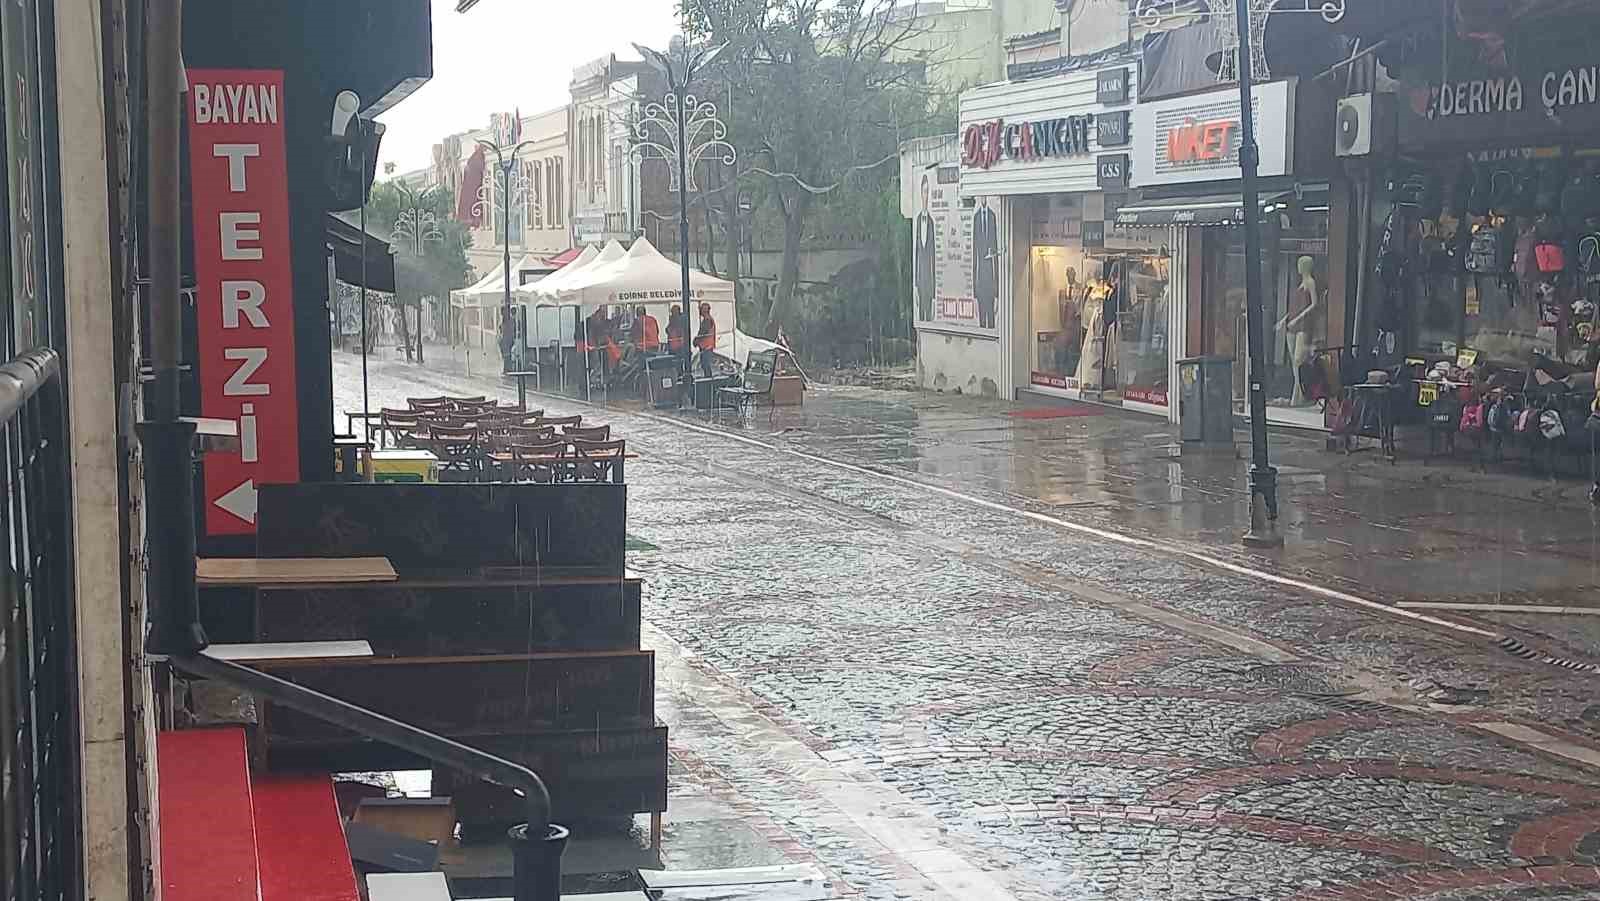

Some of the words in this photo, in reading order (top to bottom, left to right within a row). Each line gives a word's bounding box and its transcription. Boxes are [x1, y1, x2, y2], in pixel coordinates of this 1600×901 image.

[194, 84, 278, 124] BAYAN
[1439, 77, 1522, 116] DERMA
[1541, 66, 1600, 119] ÇAN
[213, 143, 271, 462] TERZİ
